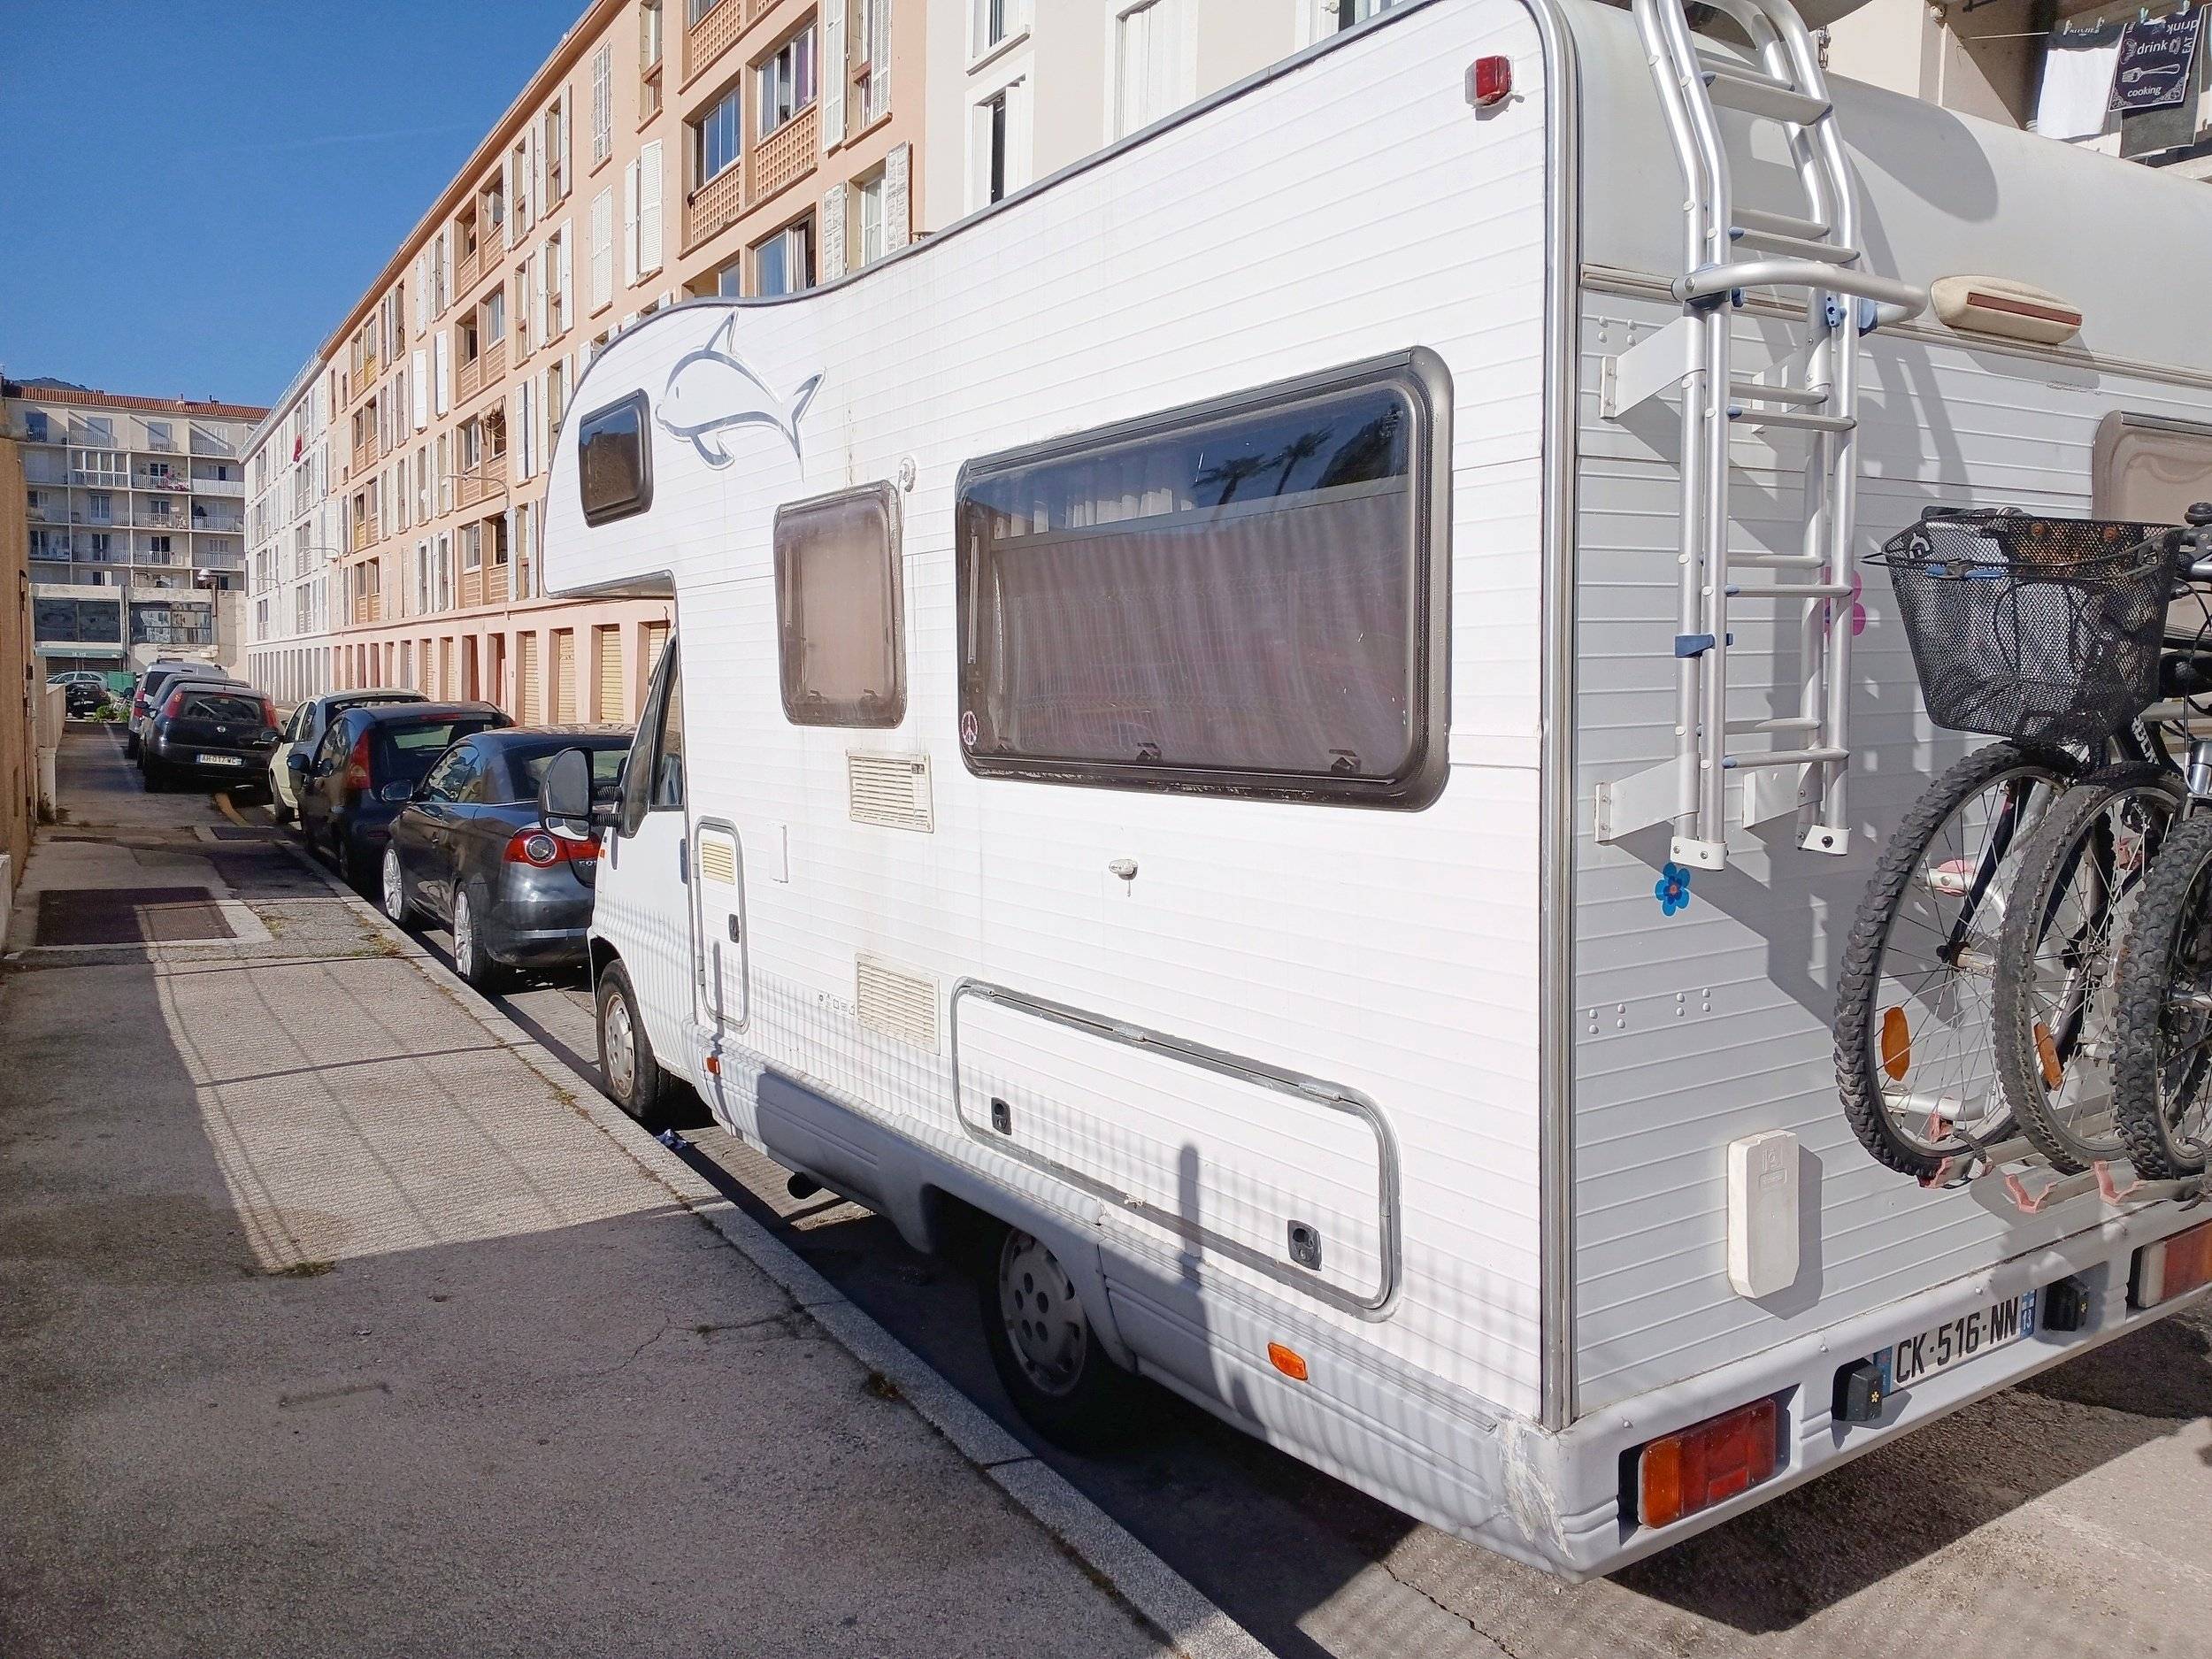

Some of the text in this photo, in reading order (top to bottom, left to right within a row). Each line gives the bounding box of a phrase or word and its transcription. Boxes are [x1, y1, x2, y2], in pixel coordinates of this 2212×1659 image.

[2137, 40, 2168, 55] drink
[2182, 36, 2193, 53] EAT
[2127, 86, 2162, 97] cooking
[2022, 1309, 2033, 1331] 13
